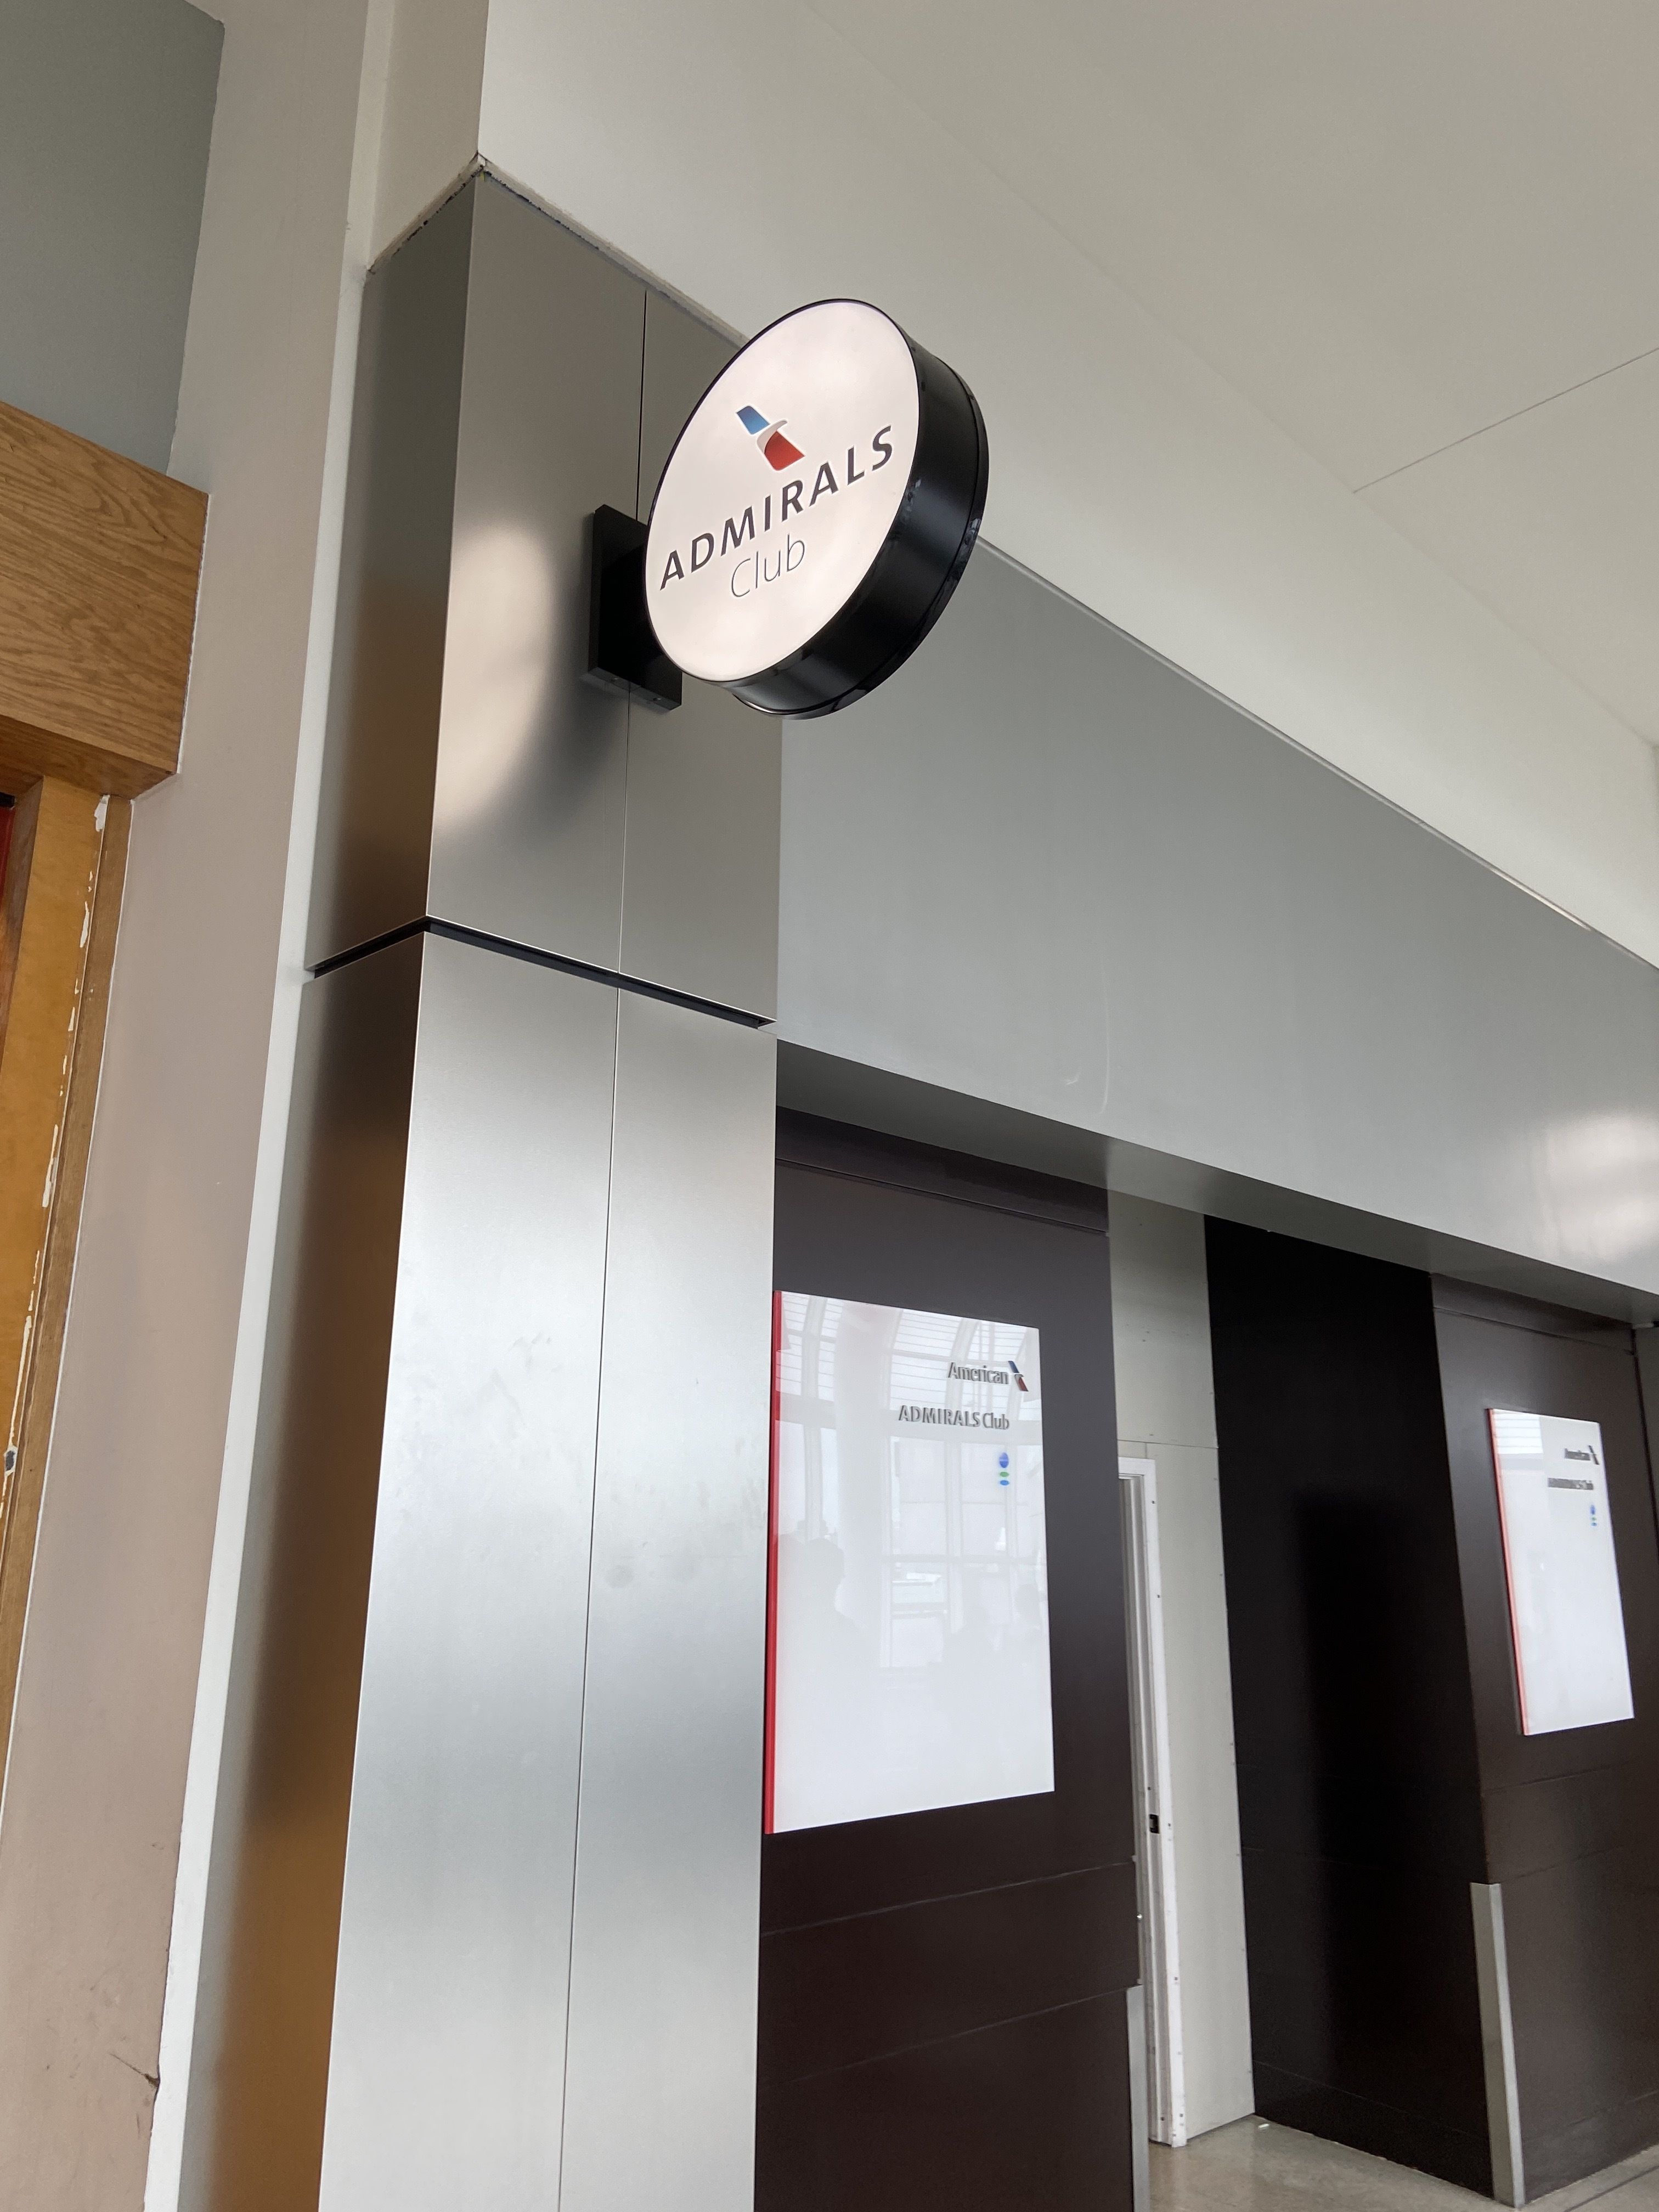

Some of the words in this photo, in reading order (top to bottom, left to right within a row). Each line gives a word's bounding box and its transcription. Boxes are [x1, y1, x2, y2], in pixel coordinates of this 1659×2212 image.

[659, 424, 894, 591] ADMIRALS
[730, 533, 805, 597] Club
[947, 1362, 1009, 1385] American
[898, 1404, 980, 1427] ADMIRALS
[983, 1412, 1010, 1430] Club
